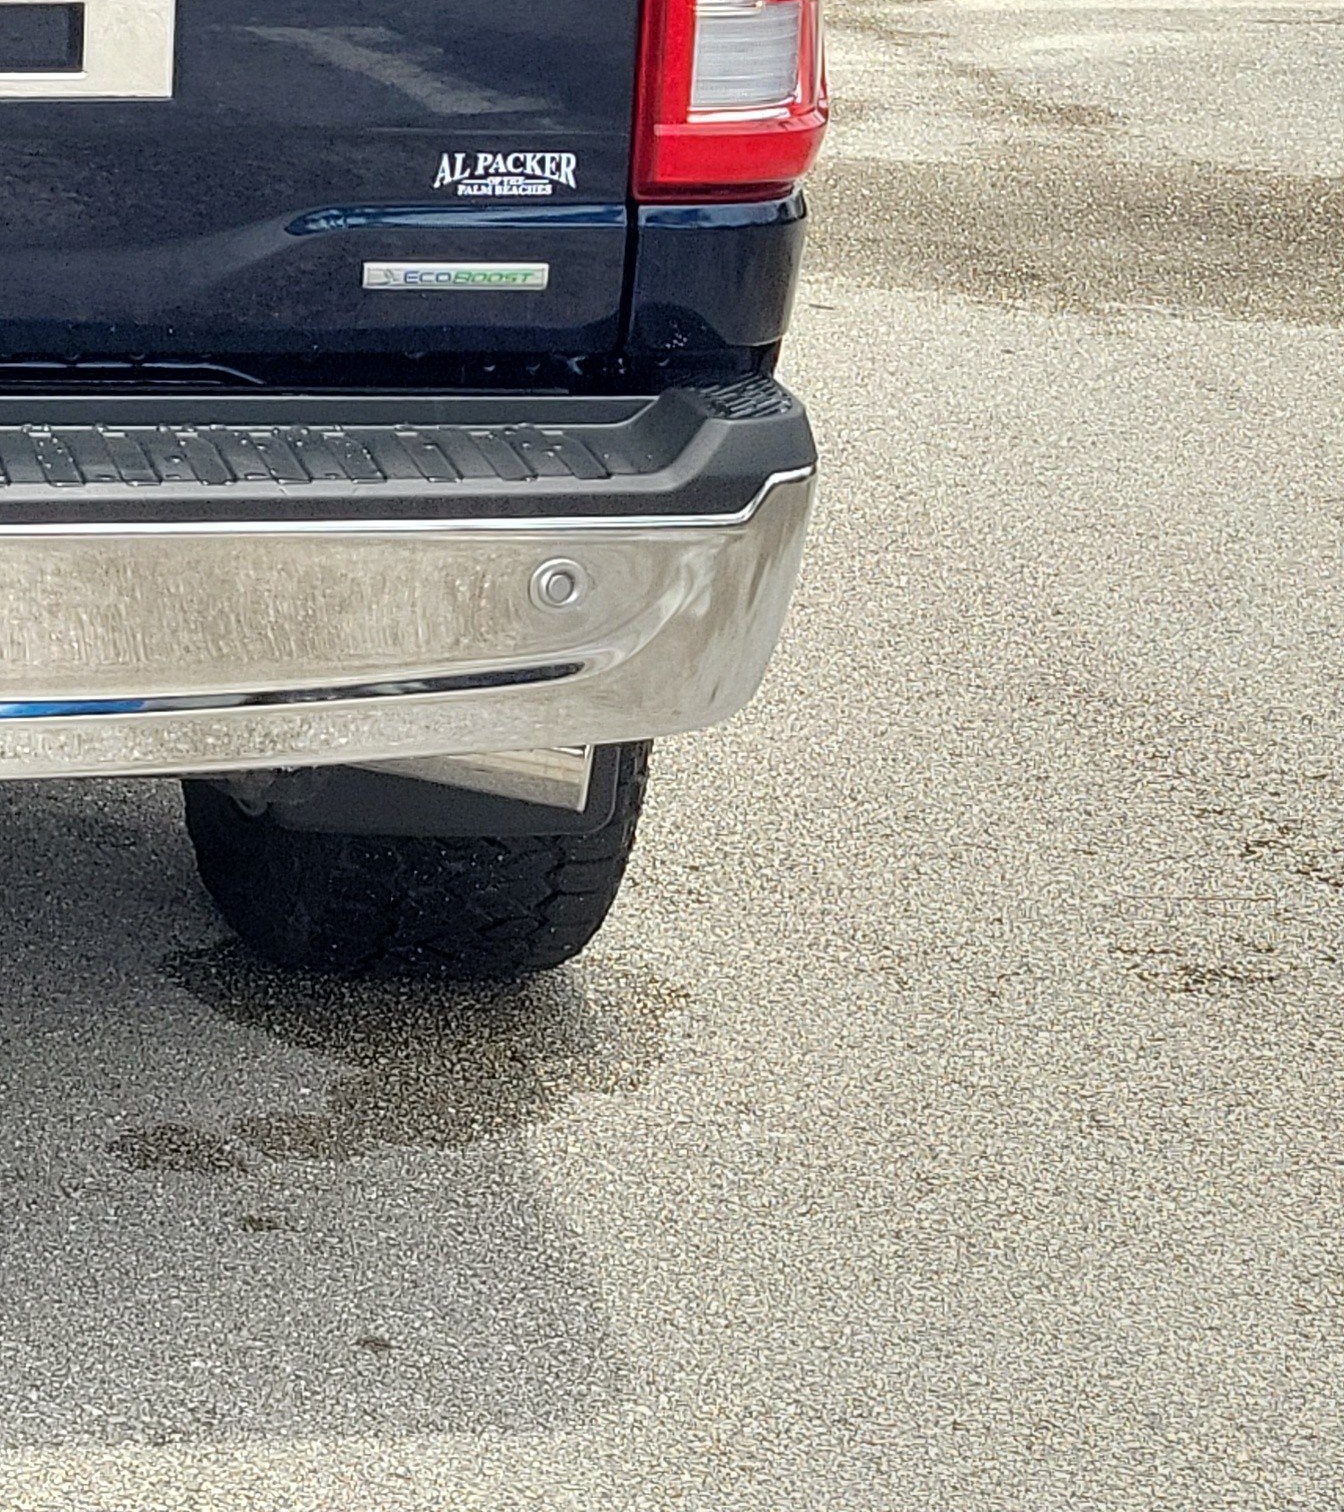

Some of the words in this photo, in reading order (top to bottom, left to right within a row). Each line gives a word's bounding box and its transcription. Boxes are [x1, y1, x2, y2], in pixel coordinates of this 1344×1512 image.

[433, 152, 471, 188] AL
[474, 152, 577, 188] PACKER
[457, 185, 492, 196] PALM
[494, 184, 553, 196] BEACHES
